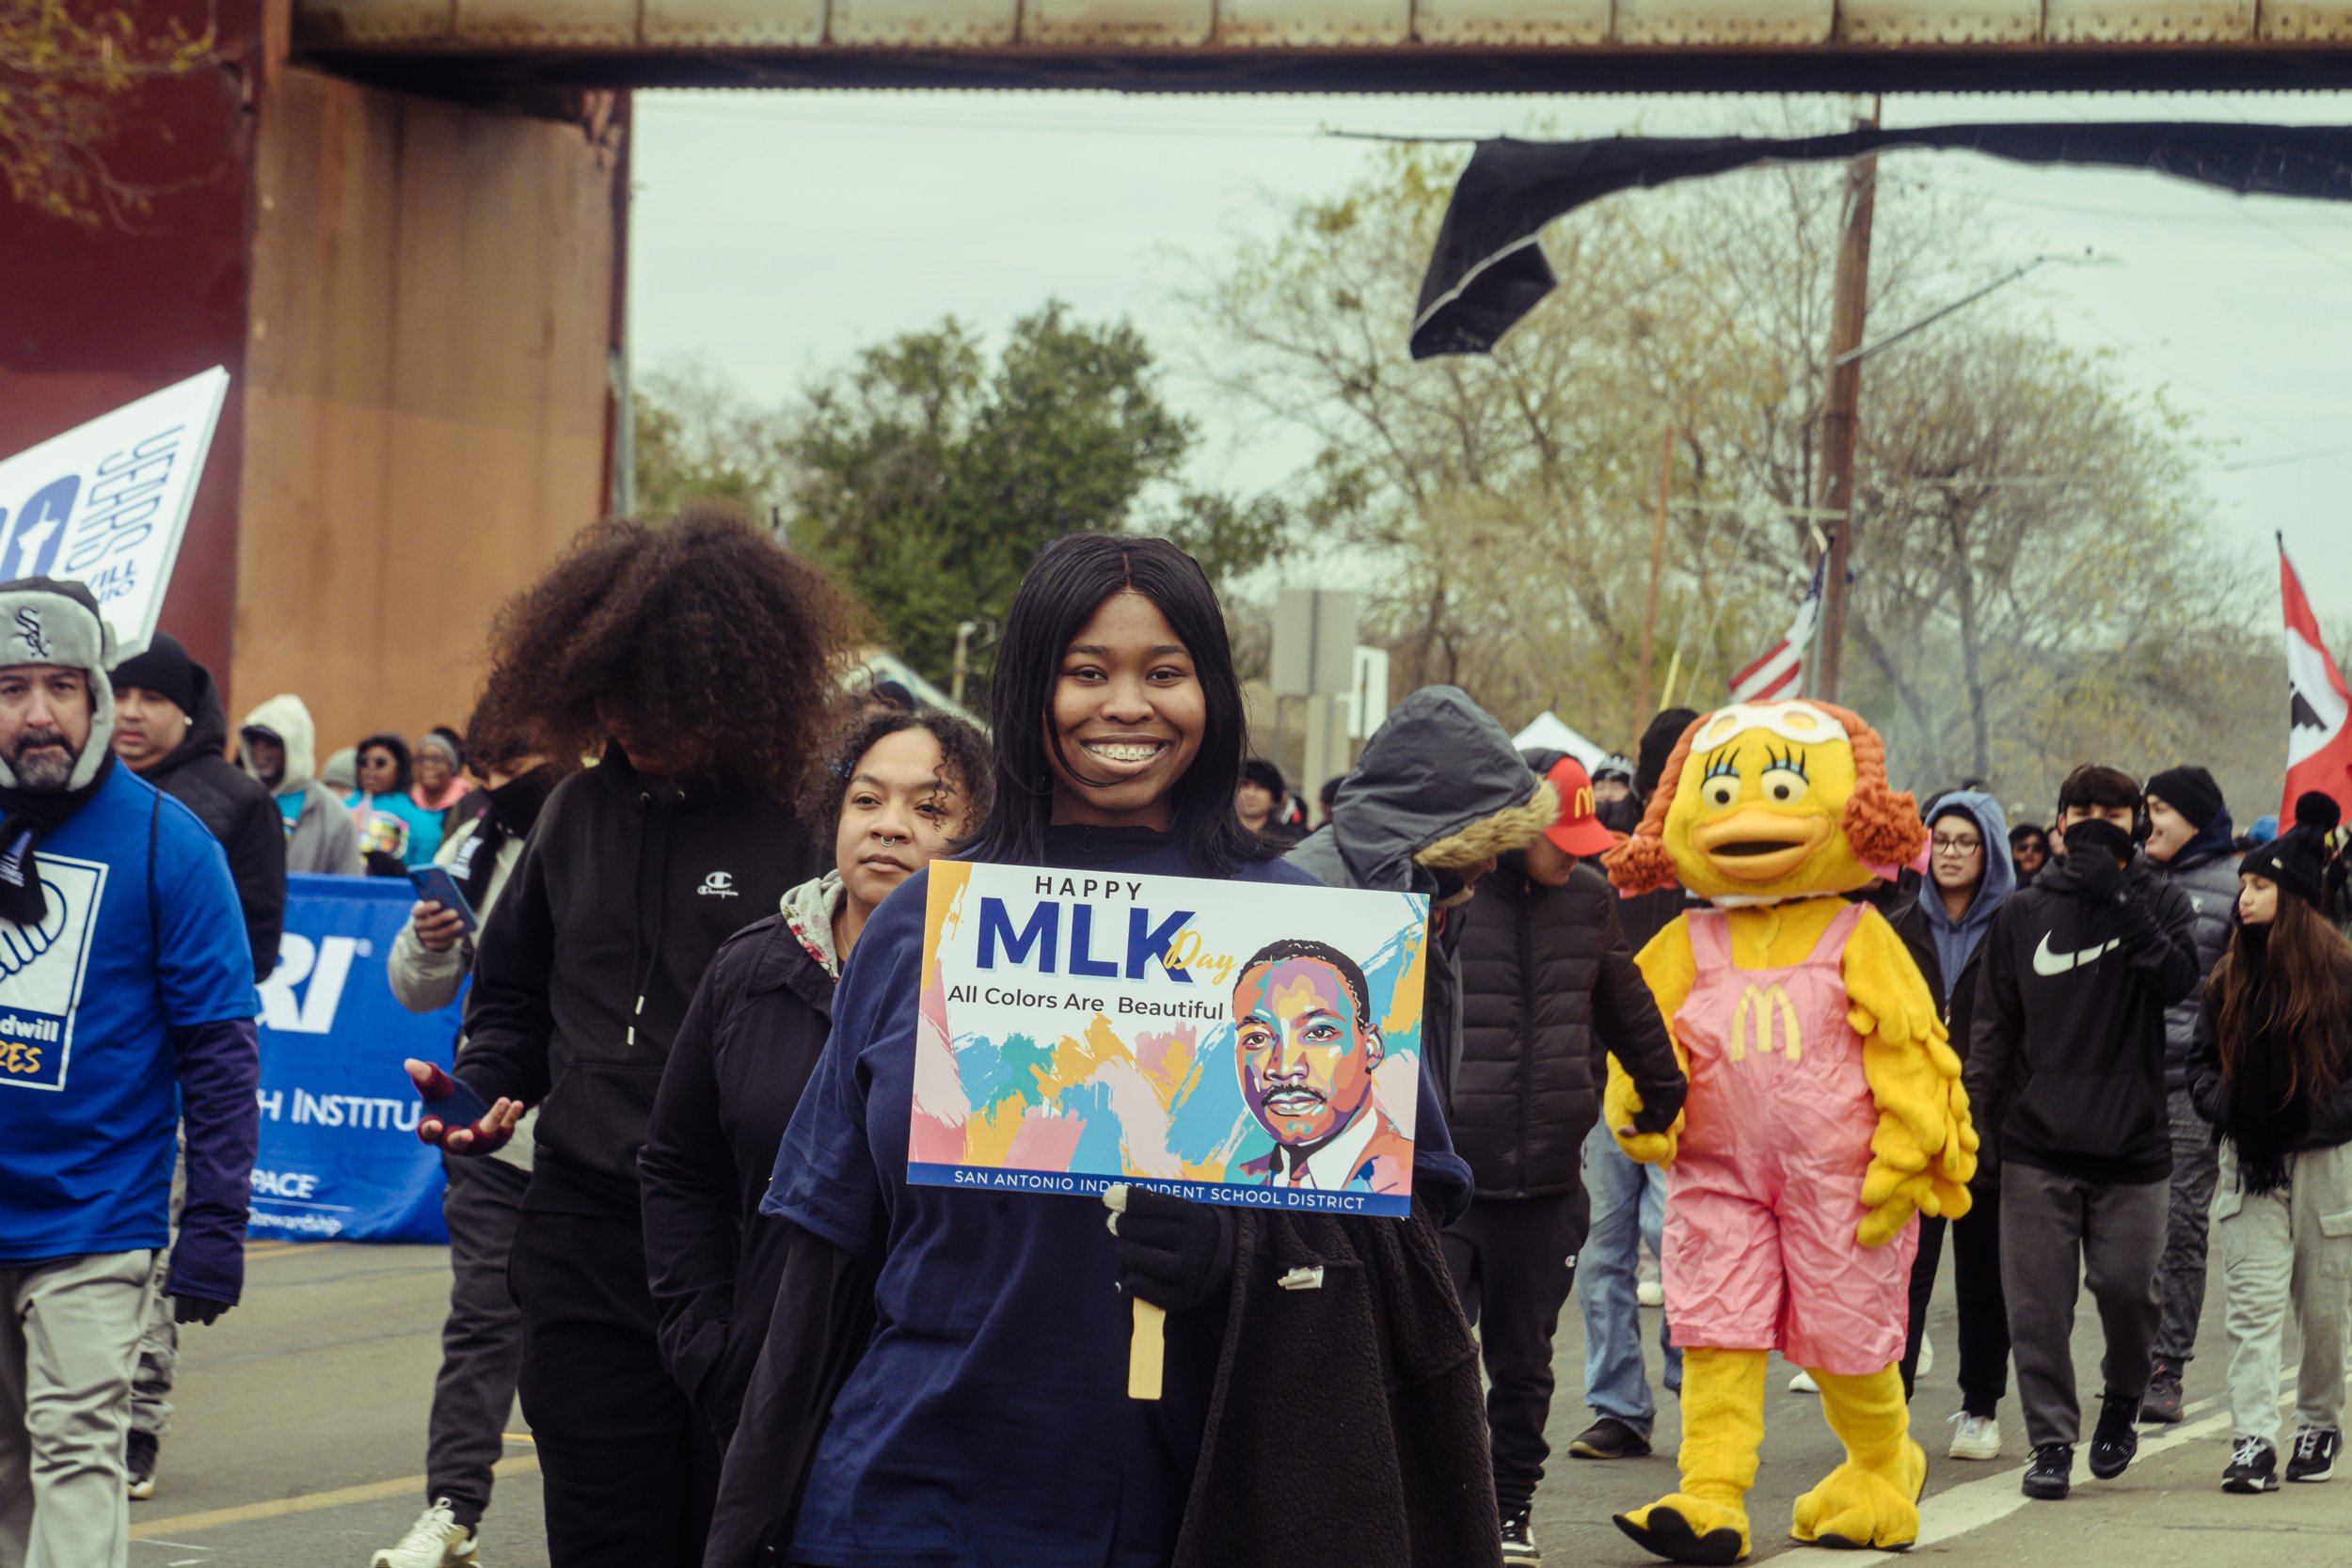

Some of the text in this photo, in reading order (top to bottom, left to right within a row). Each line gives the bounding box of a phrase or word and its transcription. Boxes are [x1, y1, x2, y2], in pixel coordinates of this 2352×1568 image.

[1035, 876, 1142, 900] HAPPY
[977, 896, 1238, 986] MLK Day
[947, 985, 1224, 1021] All Colors Are Beautiful
[0, 1014, 59, 1042] dwill
[291, 1087, 423, 1132] INSTITU
[954, 1170, 988, 1185] SAN
[993, 1173, 1073, 1191] ANTONIO
[1211, 1187, 1281, 1205] SCHOOL
[1288, 1192, 1365, 1211] DISTRICT
